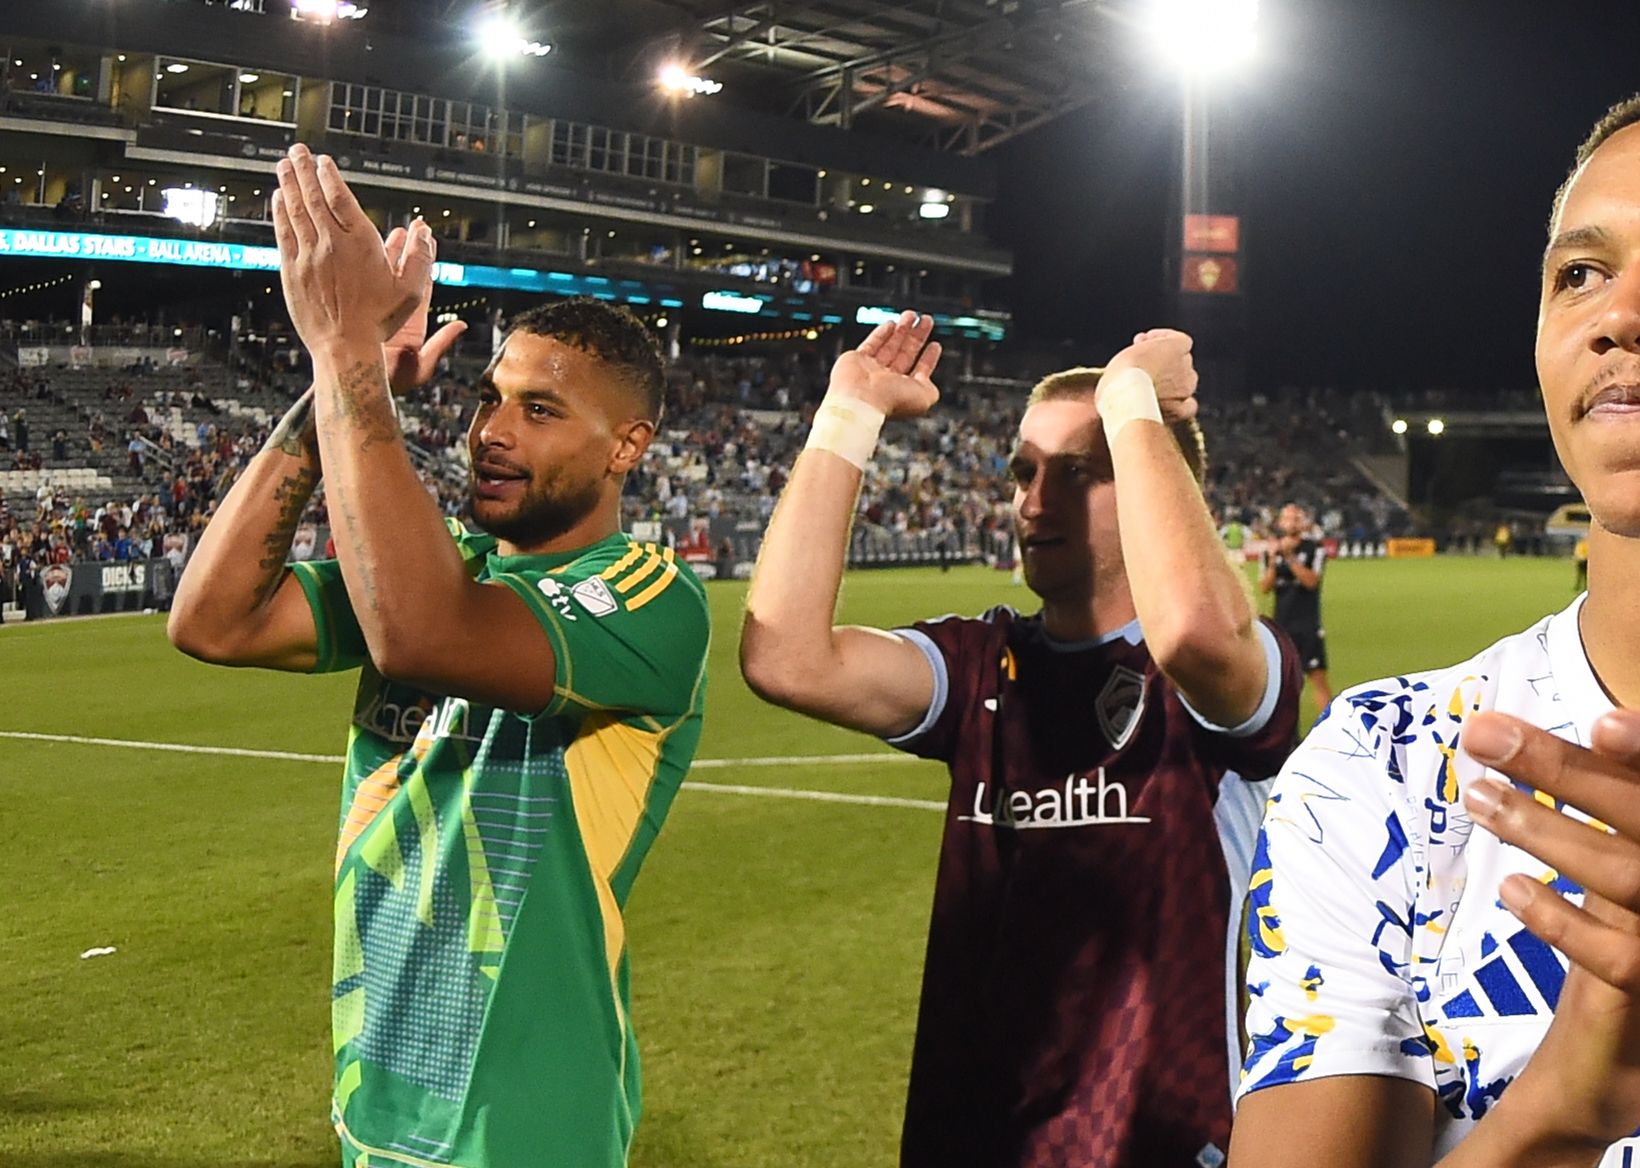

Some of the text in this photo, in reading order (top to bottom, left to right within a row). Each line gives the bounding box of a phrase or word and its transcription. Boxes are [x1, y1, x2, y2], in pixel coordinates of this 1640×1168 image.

[13, 231, 79, 254] DALLAS
[84, 236, 135, 256] STARS
[149, 239, 182, 259] BALL
[184, 244, 231, 263] ARENA
[102, 564, 145, 588] DICK'S
